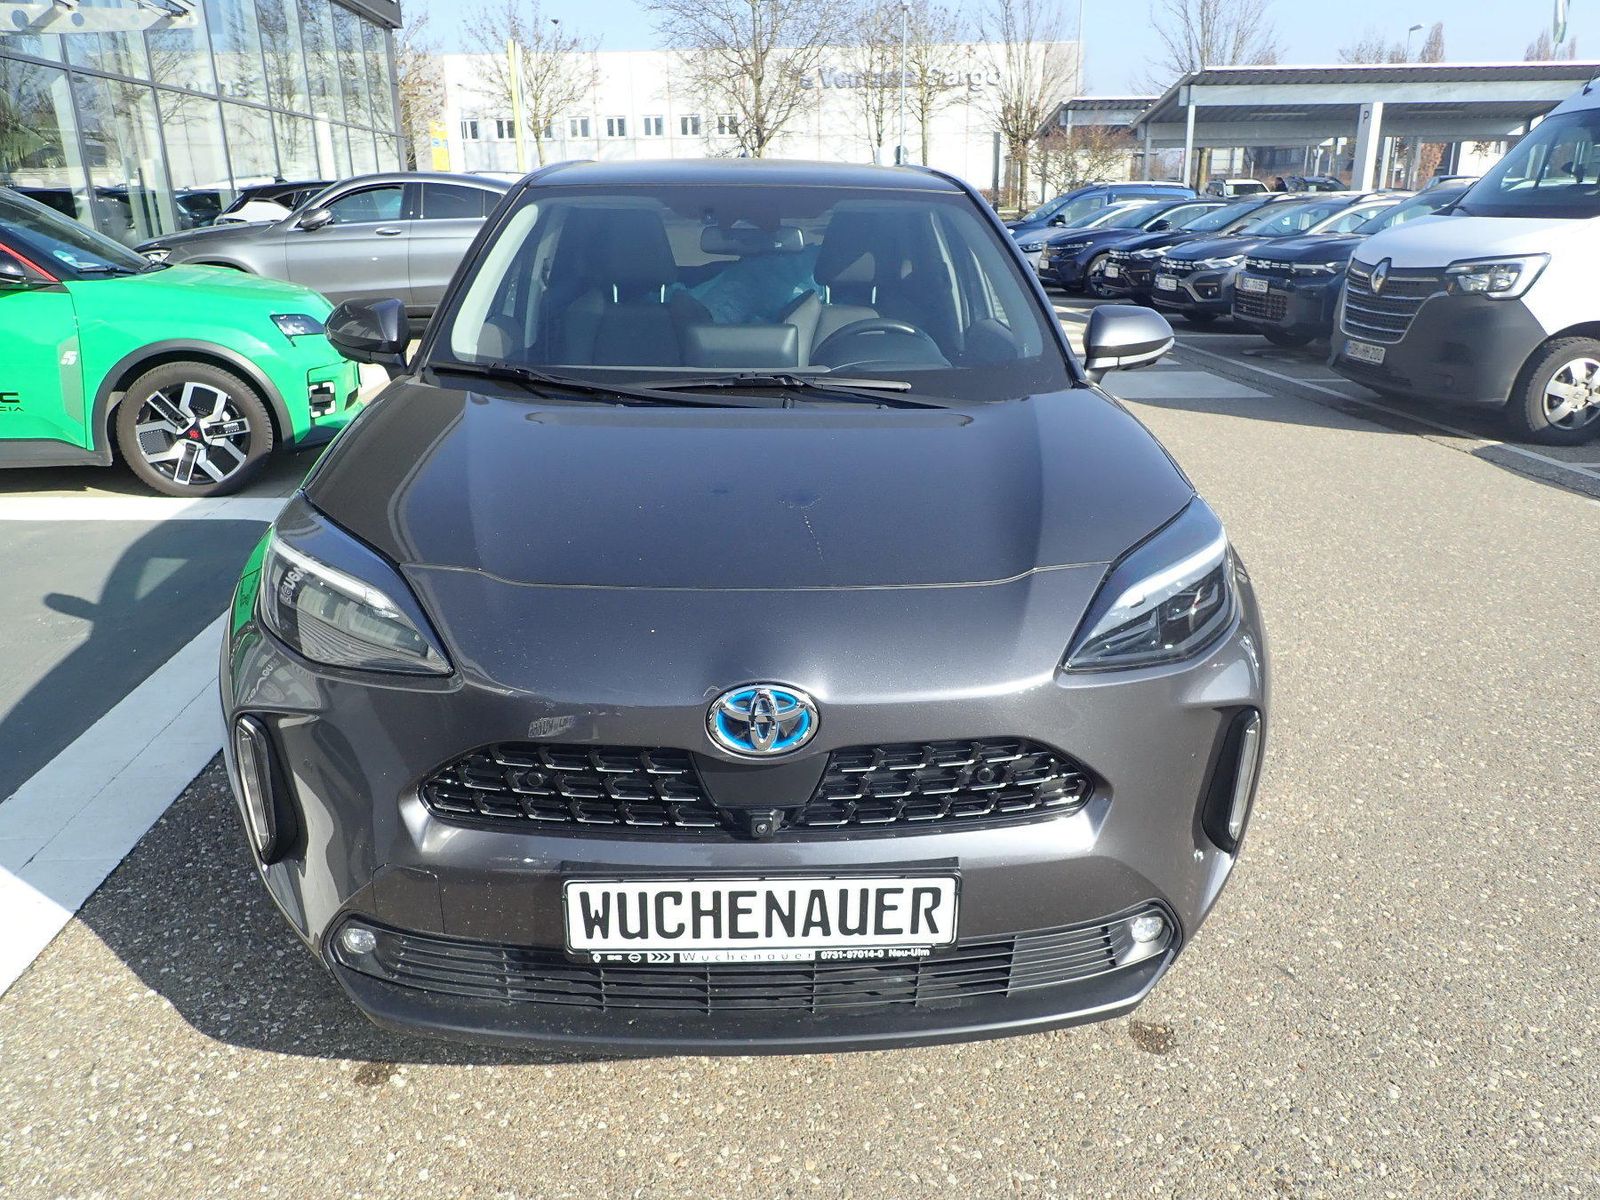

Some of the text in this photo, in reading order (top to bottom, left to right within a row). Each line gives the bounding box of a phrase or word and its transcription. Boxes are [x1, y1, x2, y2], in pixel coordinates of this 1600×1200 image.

[579, 886, 942, 940] WUCHENAUER
[682, 951, 813, 962] Wuchenauer
[888, 948, 931, 958] Neu-Ulm
